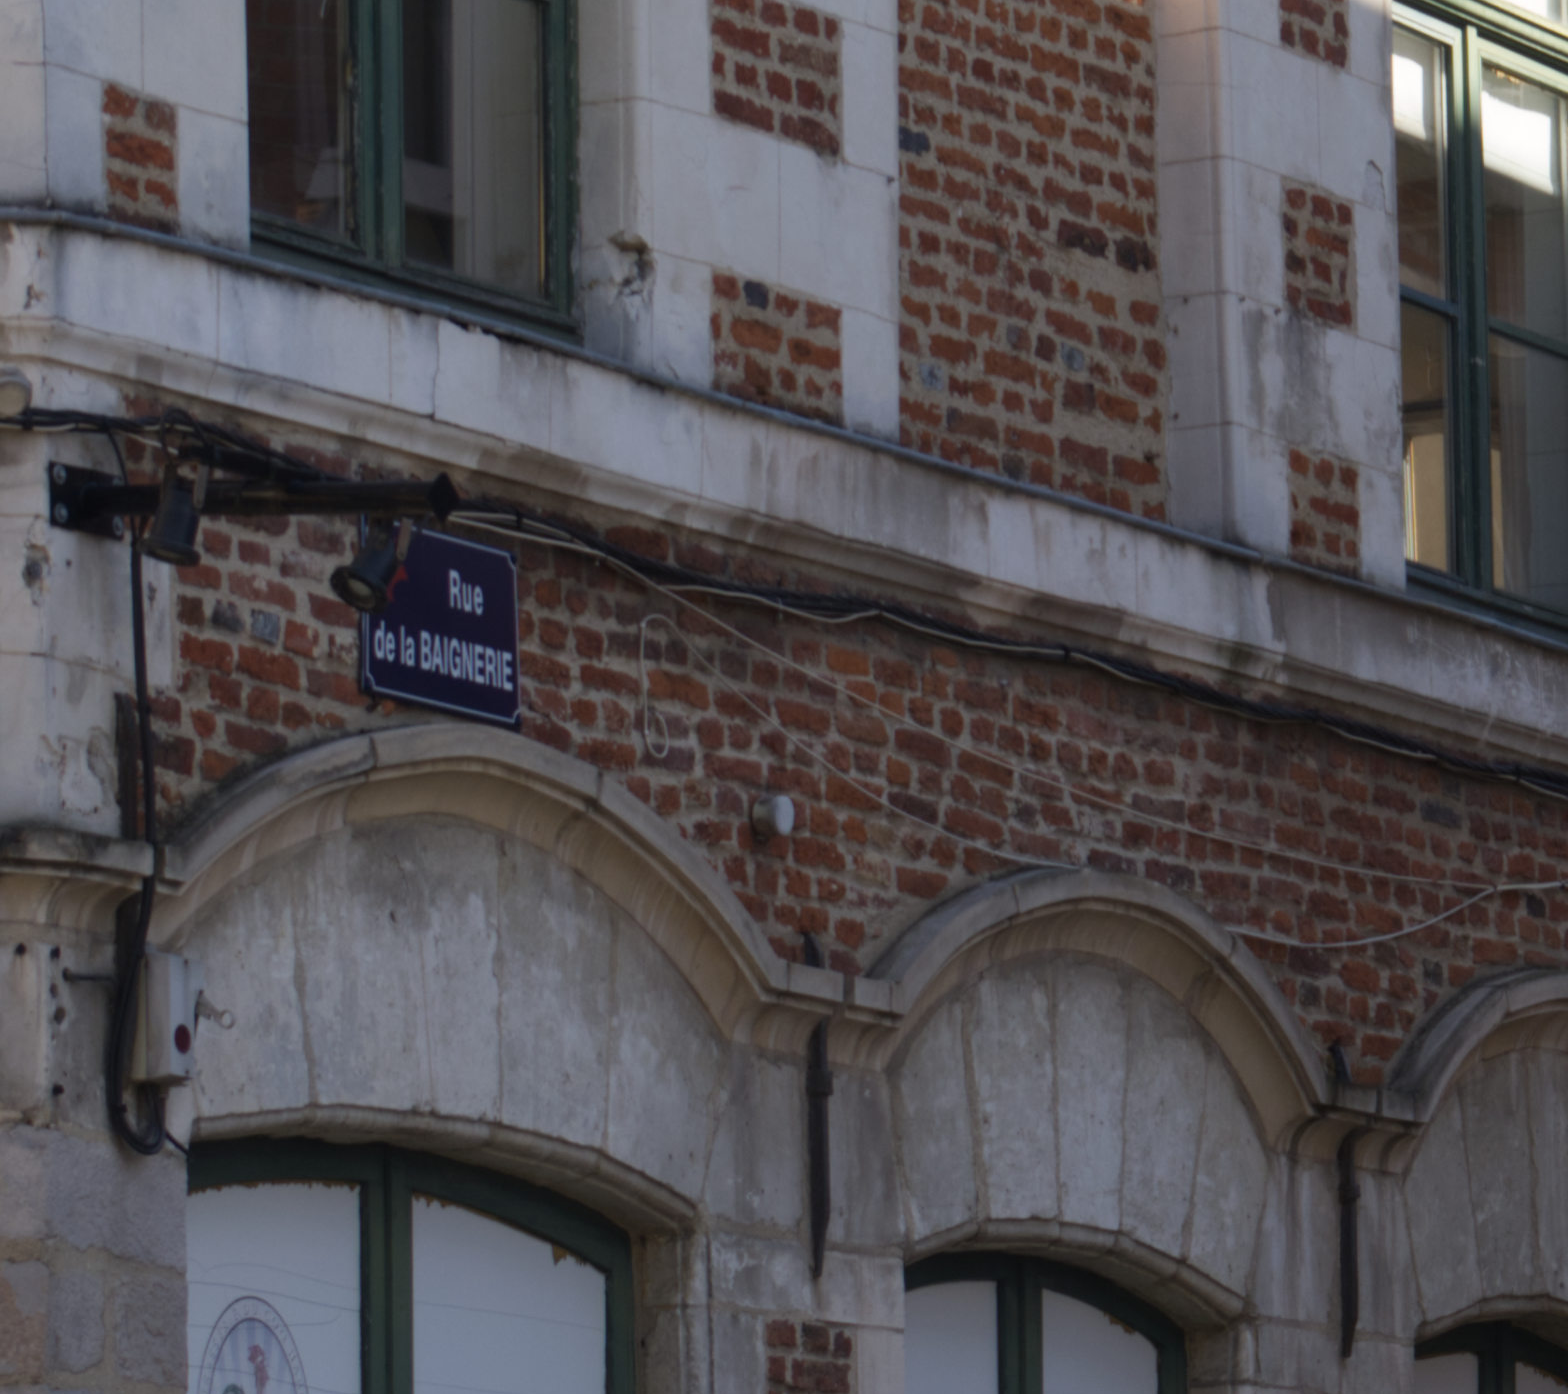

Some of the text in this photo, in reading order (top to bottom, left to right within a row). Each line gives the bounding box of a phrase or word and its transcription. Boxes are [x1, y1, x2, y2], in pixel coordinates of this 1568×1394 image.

[448, 568, 484, 616] Rue
[373, 620, 514, 692] de la BAIGNERIE
